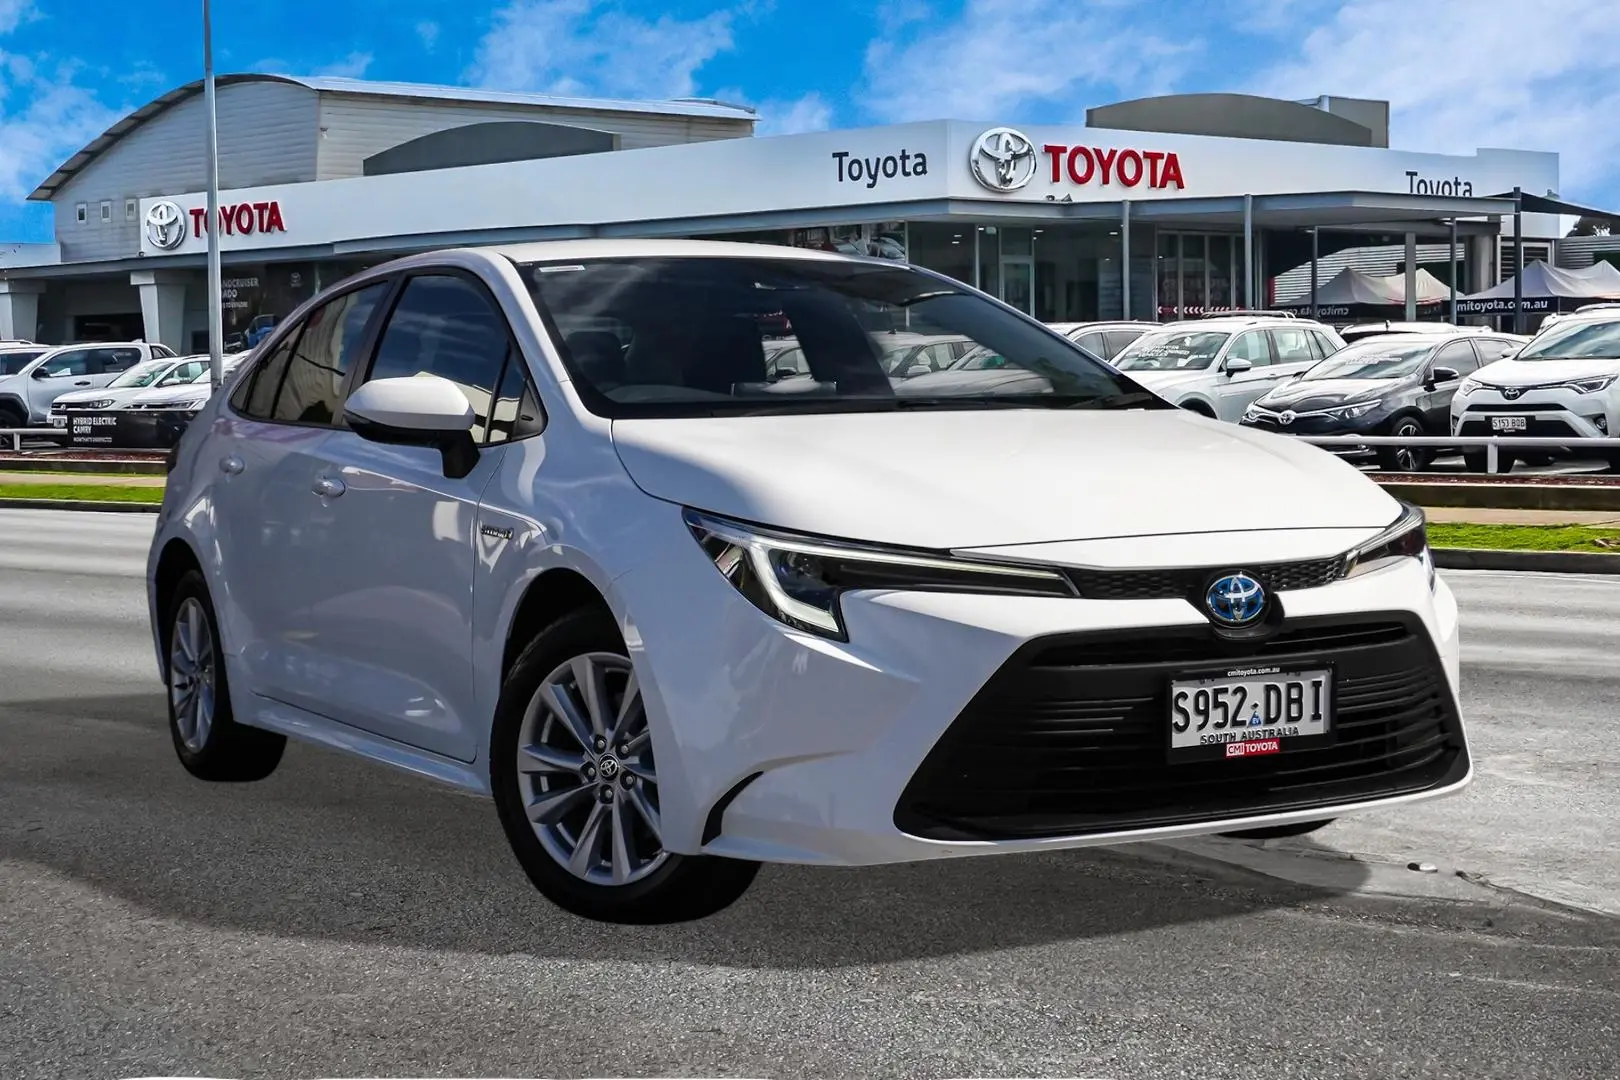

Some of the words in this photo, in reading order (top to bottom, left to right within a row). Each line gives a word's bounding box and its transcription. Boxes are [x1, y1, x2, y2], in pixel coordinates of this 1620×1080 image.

[832, 149, 928, 188] Toyota
[1044, 144, 1184, 189] TOYOTA
[1456, 300, 1548, 313] mitoyota.cm.au
[1227, 667, 1281, 677] cmitoyota.com.au
[1172, 685, 1248, 733] S952
[1264, 679, 1323, 725] DBI
[1200, 732, 1236, 744] SOUTH
[1241, 727, 1299, 740] AUSTRALIA
[1227, 744, 1244, 755] CMI
[1246, 741, 1278, 753] TOYOTA
